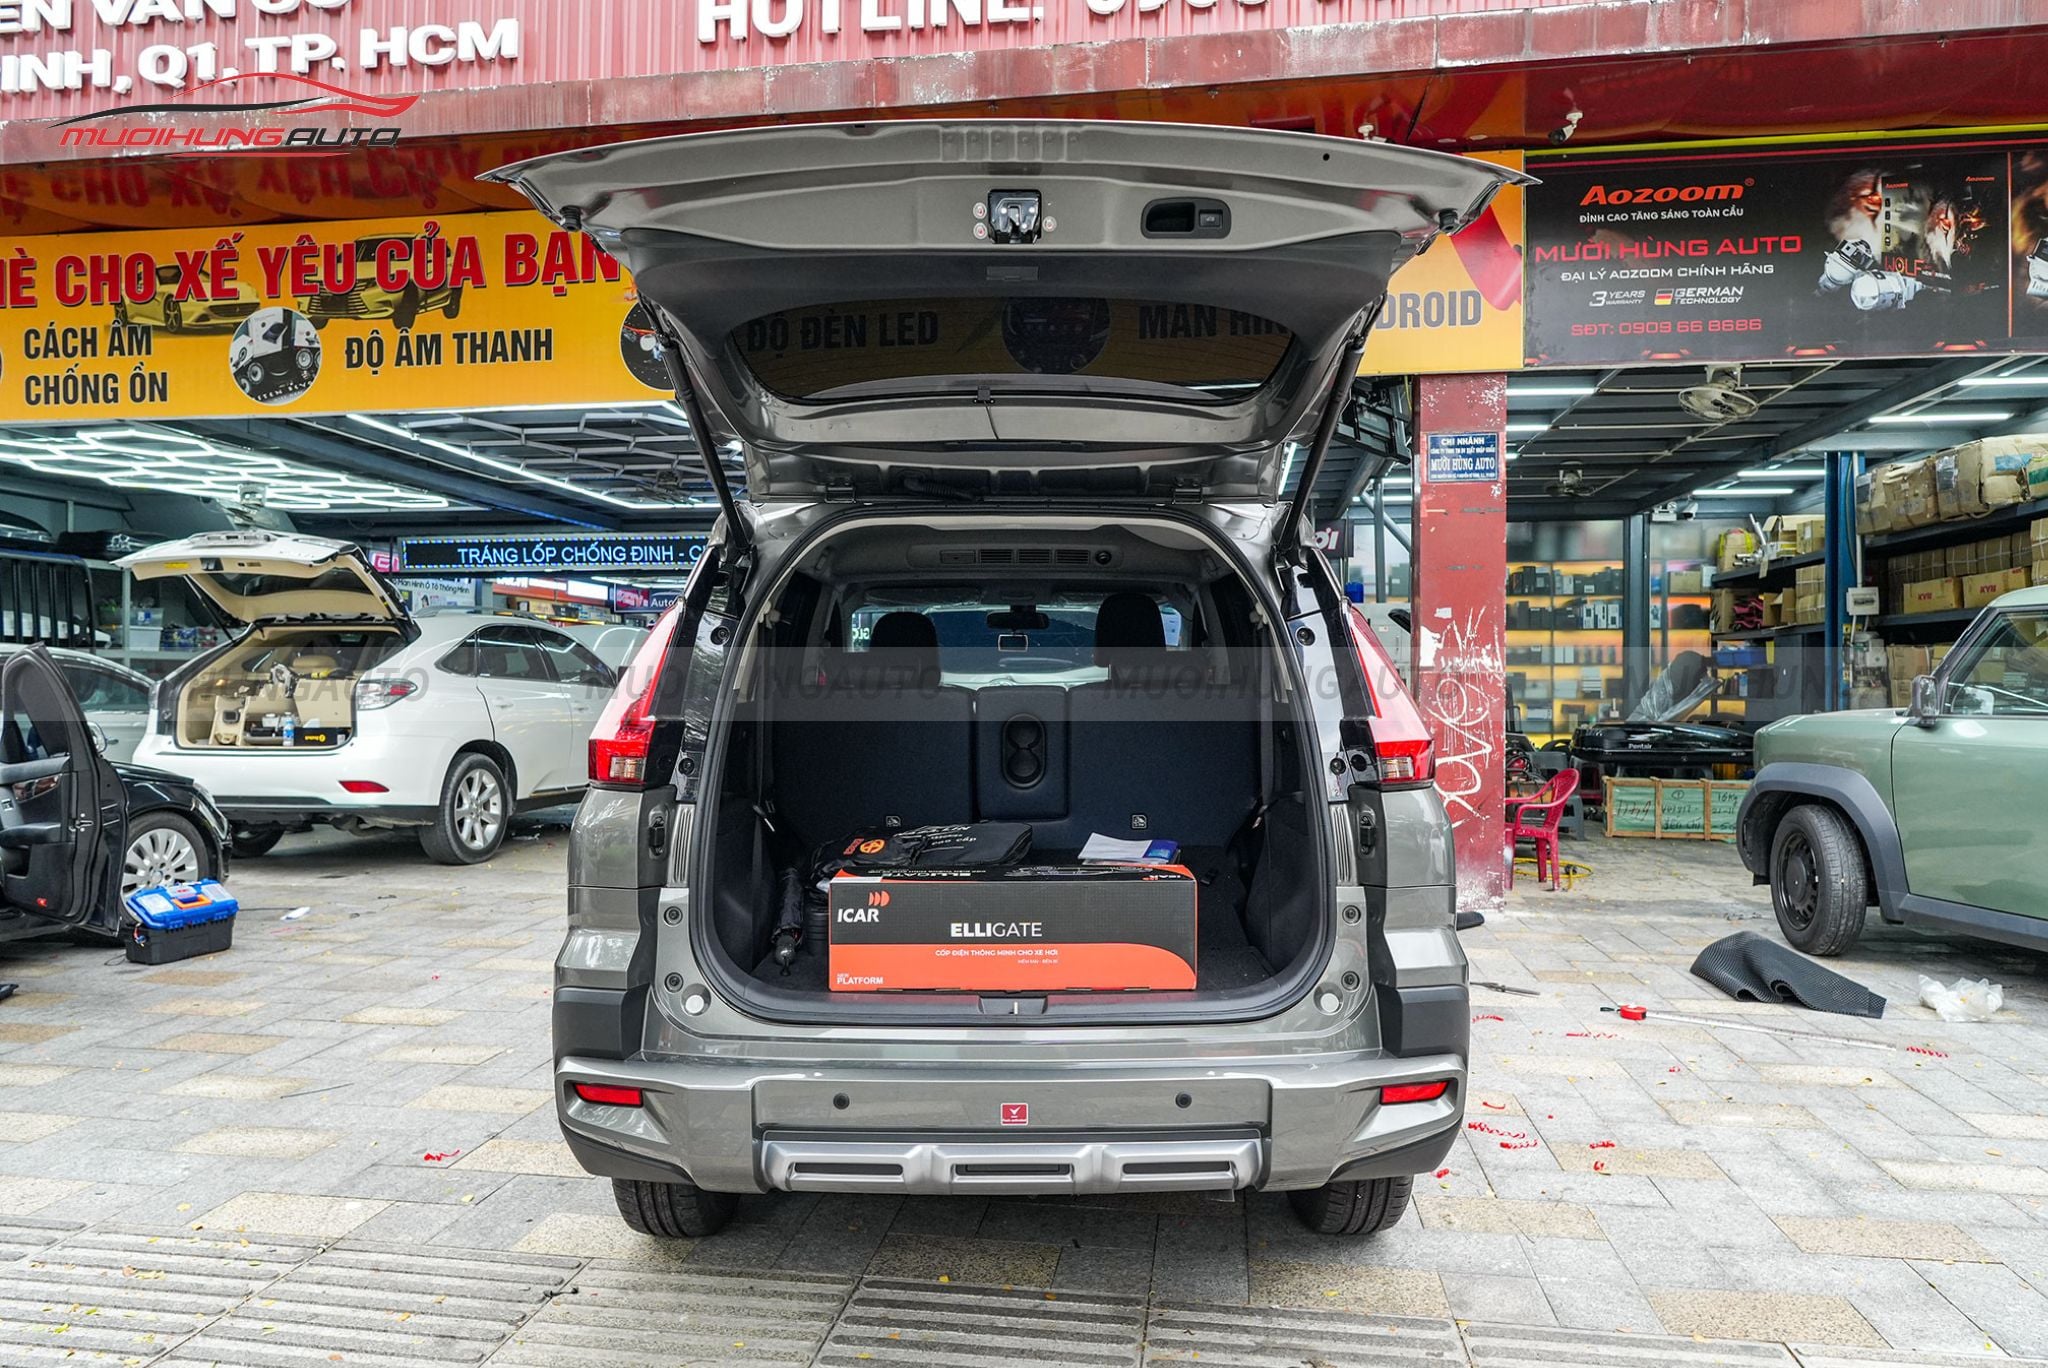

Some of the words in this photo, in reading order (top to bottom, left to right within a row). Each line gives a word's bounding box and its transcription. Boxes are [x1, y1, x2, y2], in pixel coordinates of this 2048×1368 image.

[360, 18, 519, 69] HCM
[1606, 213, 1629, 222] CAO
[1661, 209, 1689, 220] SÁNG
[1691, 207, 1721, 218] TOÀN
[1619, 237, 1709, 260] HÙNG
[1716, 235, 1802, 256] AUTO
[54, 252, 158, 307] CHO
[174, 231, 245, 303] XẾ
[257, 233, 358, 298] YÊU
[375, 220, 487, 292] CỦA
[504, 231, 621, 296] BẠN
[1561, 272, 1586, 284] ĐẠI
[1589, 268, 1606, 281] LÝ
[1609, 267, 1673, 280] AOZOOM
[1677, 264, 1727, 278] CHÍNH
[1730, 262, 1774, 276] HÃNG
[1589, 291, 1607, 307] 3
[1608, 290, 1646, 299] YEARS
[1674, 286, 1744, 298] GERMAN
[1674, 297, 1742, 305] TECHNOLOGY
[879, 310, 938, 347] LED
[1619, 321, 1672, 334] 0909
[1677, 321, 1703, 333] 66
[24, 323, 98, 360] CÁCH
[107, 319, 153, 357] ÂM
[345, 329, 384, 376] ĐỘ
[394, 327, 443, 367] ÂM
[452, 327, 554, 366] THANH
[24, 363, 120, 406] CHỐNG
[128, 361, 168, 404] ỒN
[1475, 457, 1495, 470] AUTO
[457, 545, 518, 564] TRÁNG
[523, 542, 556, 563] LỐP
[562, 541, 627, 563] CHỐNG
[630, 546, 674, 562] ĐINH
[837, 908, 880, 923] ICAR
[951, 922, 1043, 938] ELLIGATE
[971, 948, 996, 956] THÔNG
[837, 977, 884, 985] PLATFORM
